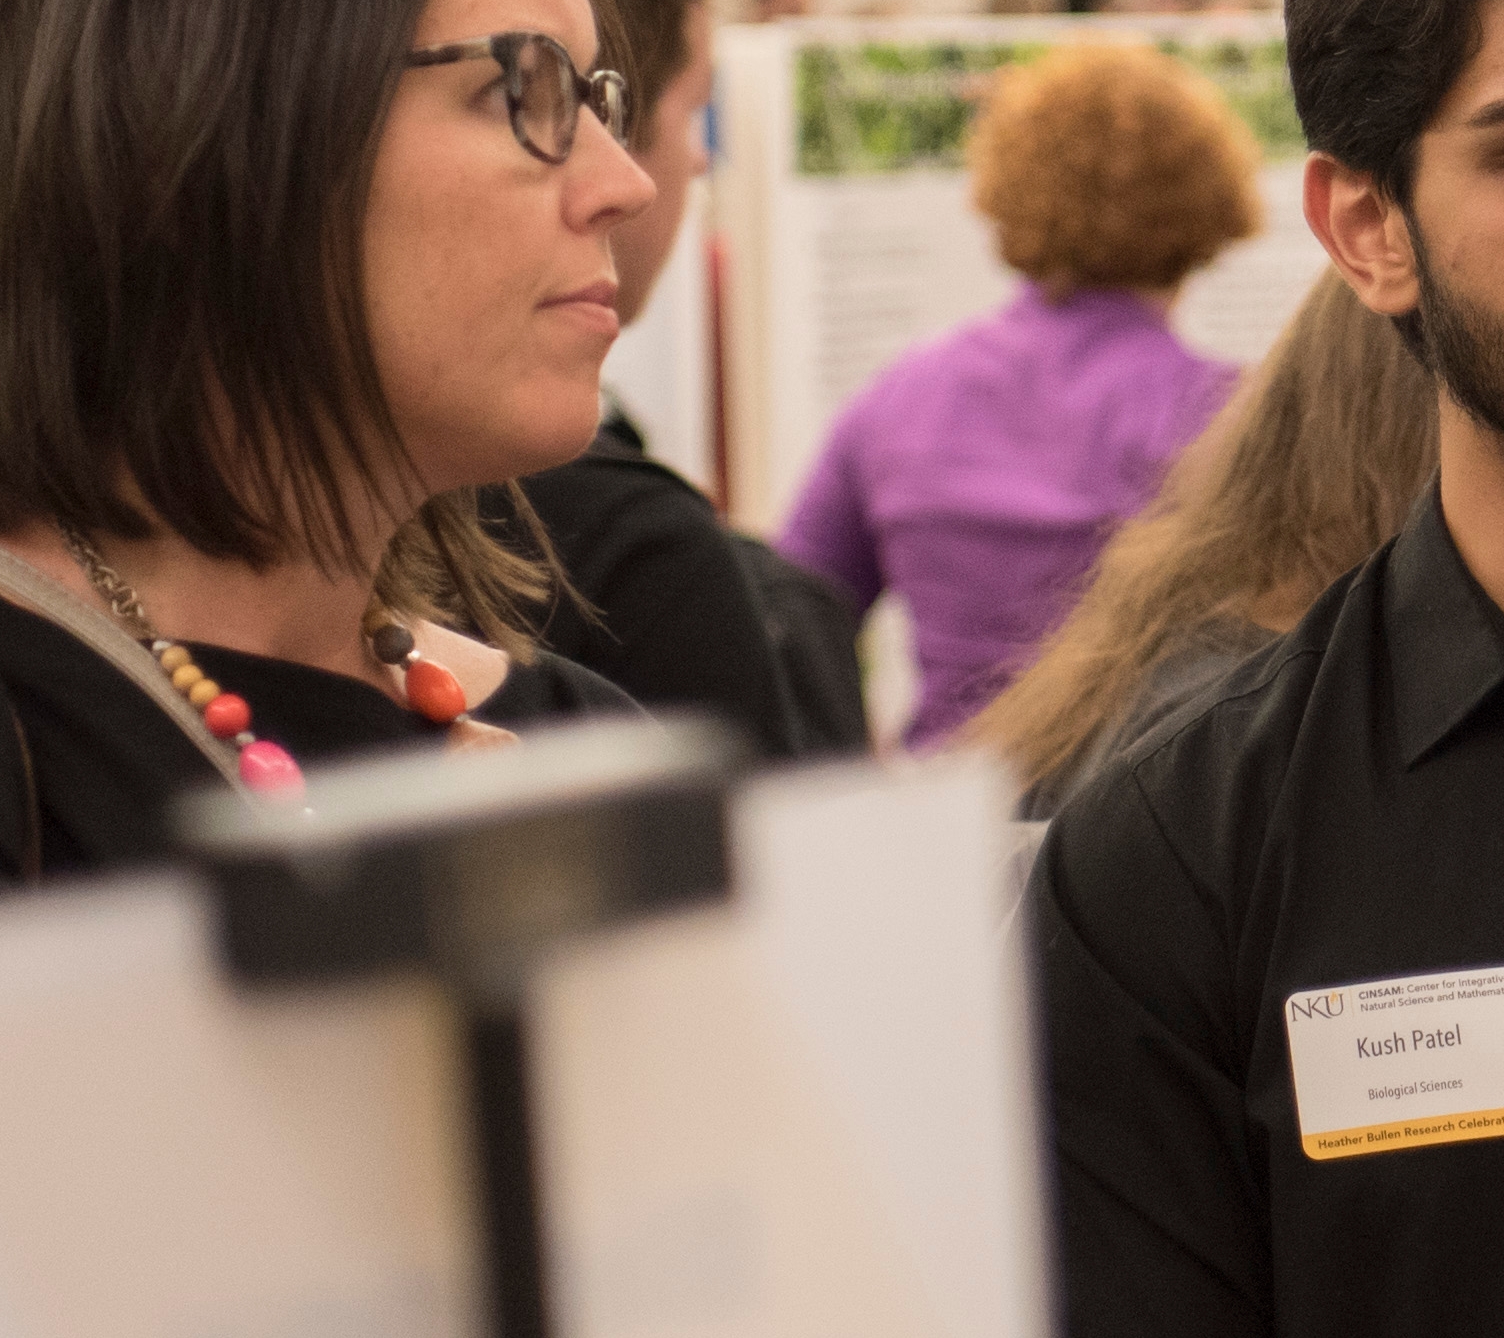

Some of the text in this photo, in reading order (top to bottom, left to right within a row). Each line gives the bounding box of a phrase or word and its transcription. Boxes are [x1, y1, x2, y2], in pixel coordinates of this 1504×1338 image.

[1358, 986, 1404, 1001] CINSAM:
[1407, 983, 1439, 994] Center
[1442, 979, 1456, 989] for
[1360, 998, 1396, 1013] Natural
[1398, 996, 1434, 1007] Science
[1437, 992, 1455, 1002] and
[1290, 992, 1345, 1022] NKU
[1356, 1023, 1462, 1059] Kush Patel
[1368, 1078, 1464, 1101] Biological Sciences
[1317, 1135, 1364, 1150] Heather
[1367, 1128, 1401, 1143] Bullen
[1404, 1121, 1456, 1137] Research
